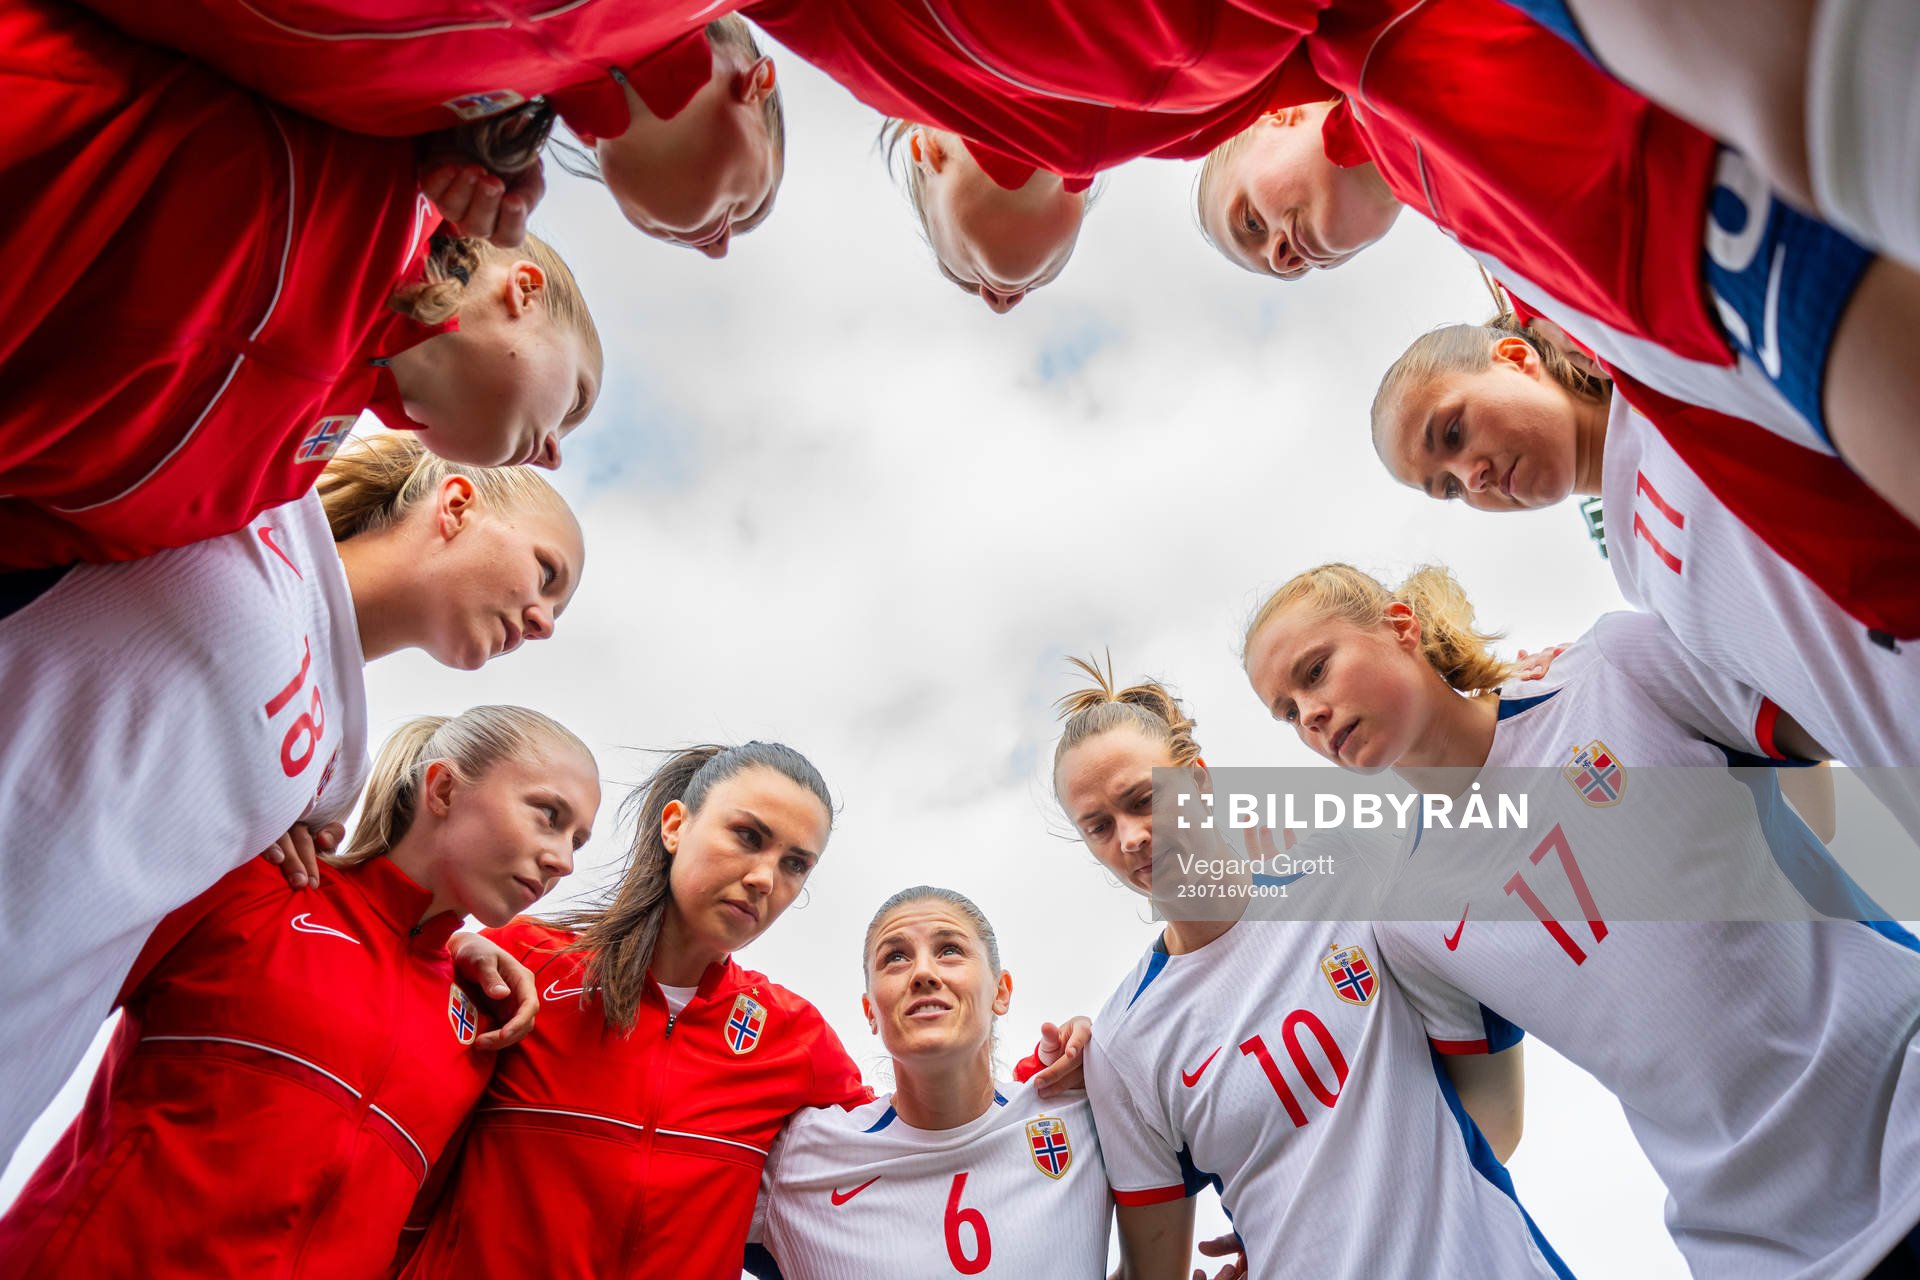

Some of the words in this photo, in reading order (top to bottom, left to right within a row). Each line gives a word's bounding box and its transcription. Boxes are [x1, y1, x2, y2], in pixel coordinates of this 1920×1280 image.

[1633, 469, 1685, 576] 11
[264, 633, 325, 778] 18
[1503, 822, 1609, 967] 17
[1239, 1008, 1349, 1129] 10
[943, 1171, 992, 1276] 6
